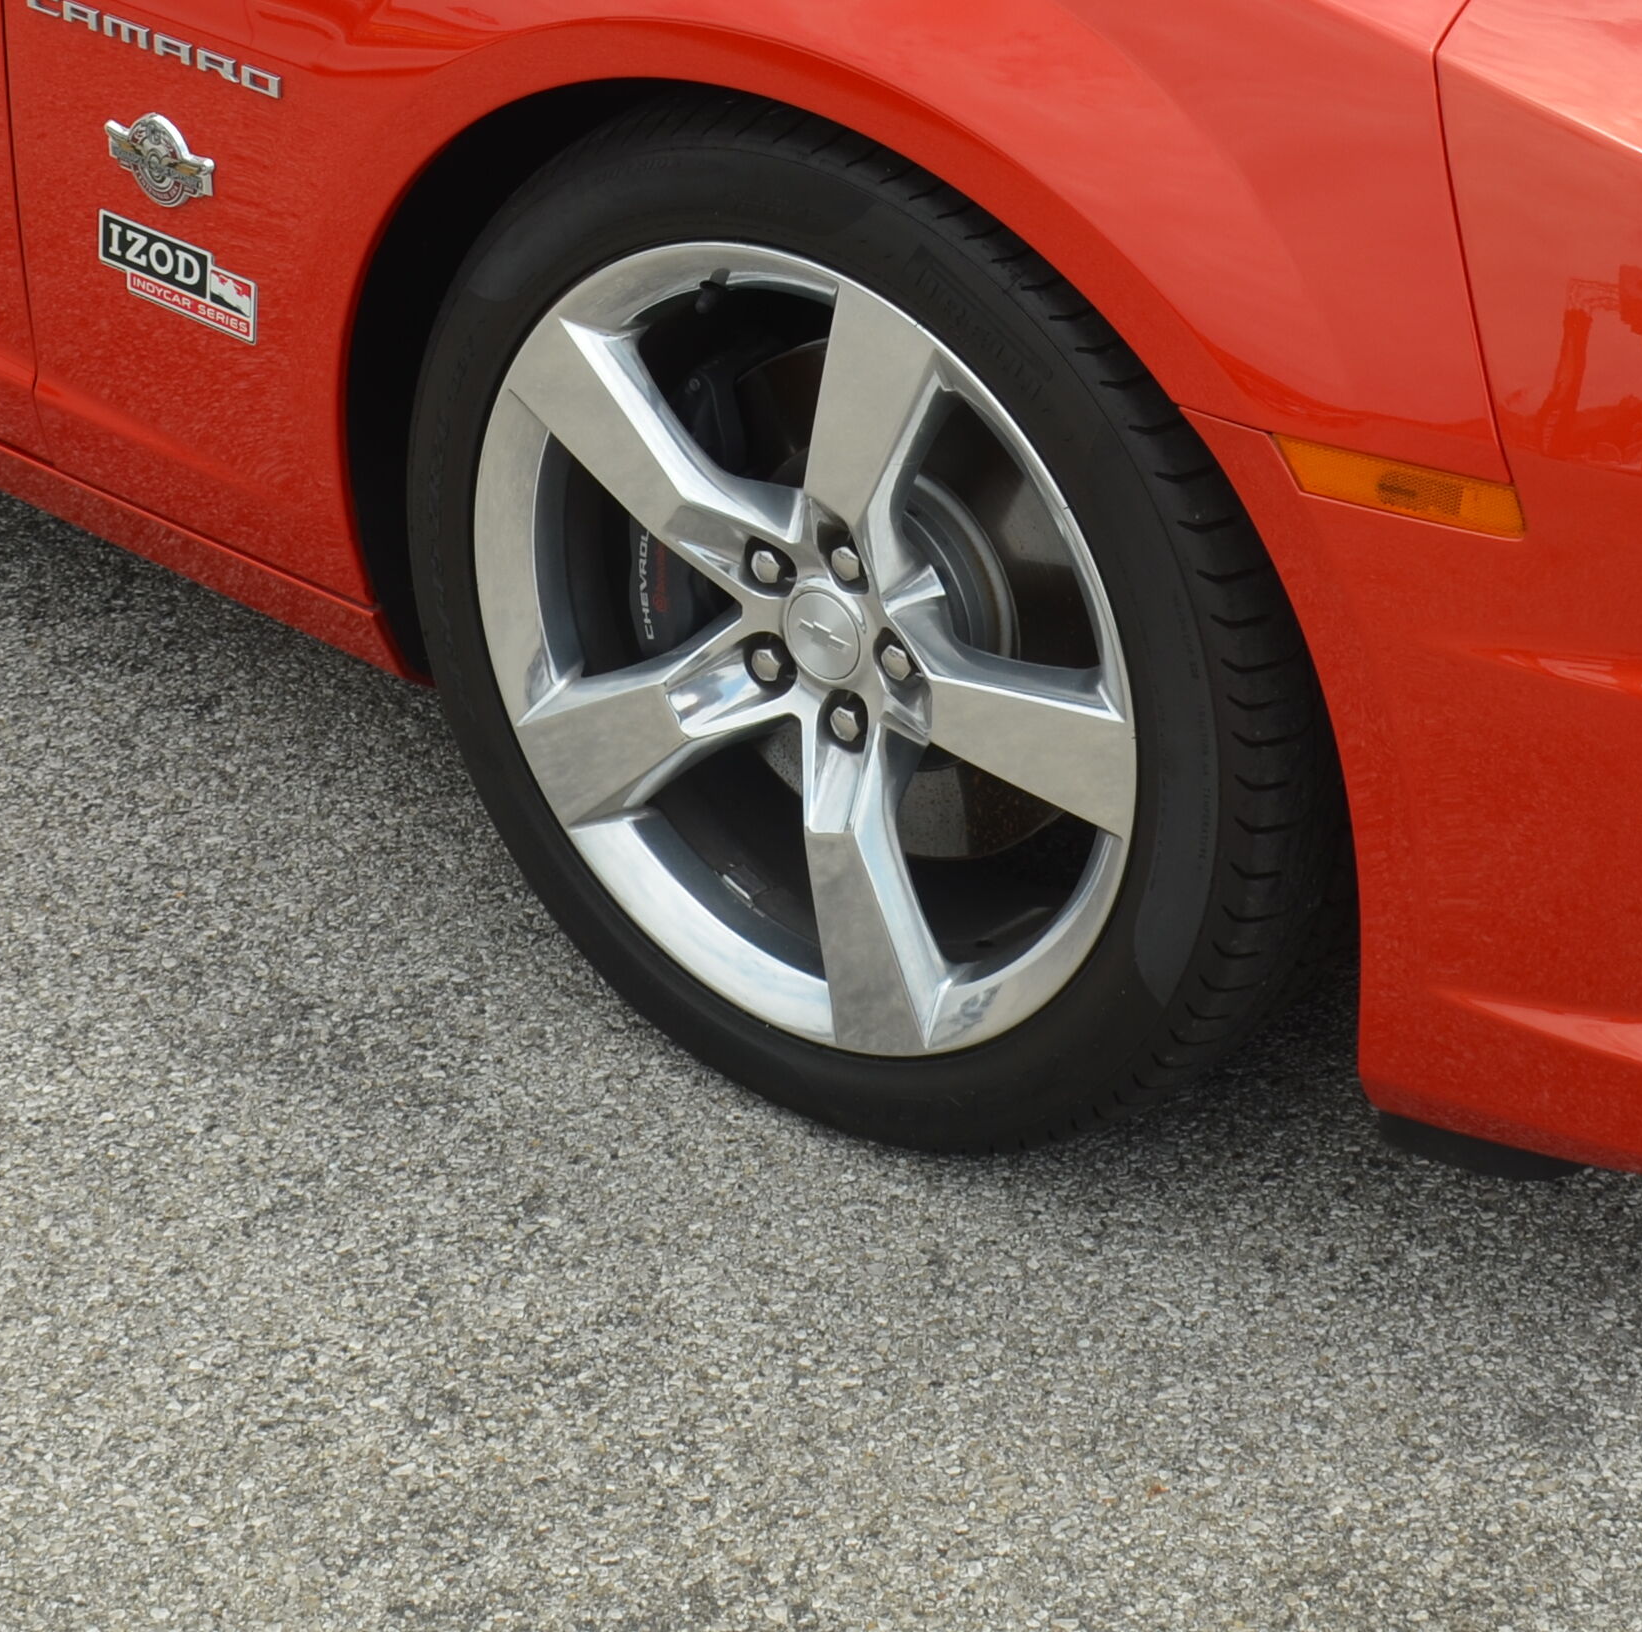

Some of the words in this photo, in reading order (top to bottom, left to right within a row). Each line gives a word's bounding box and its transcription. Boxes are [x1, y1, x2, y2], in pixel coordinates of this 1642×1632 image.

[109, 222, 201, 286] IZOD
[132, 276, 192, 309] INDYCAR
[197, 304, 248, 333] SERIES
[639, 530, 655, 640] CHEVROL
